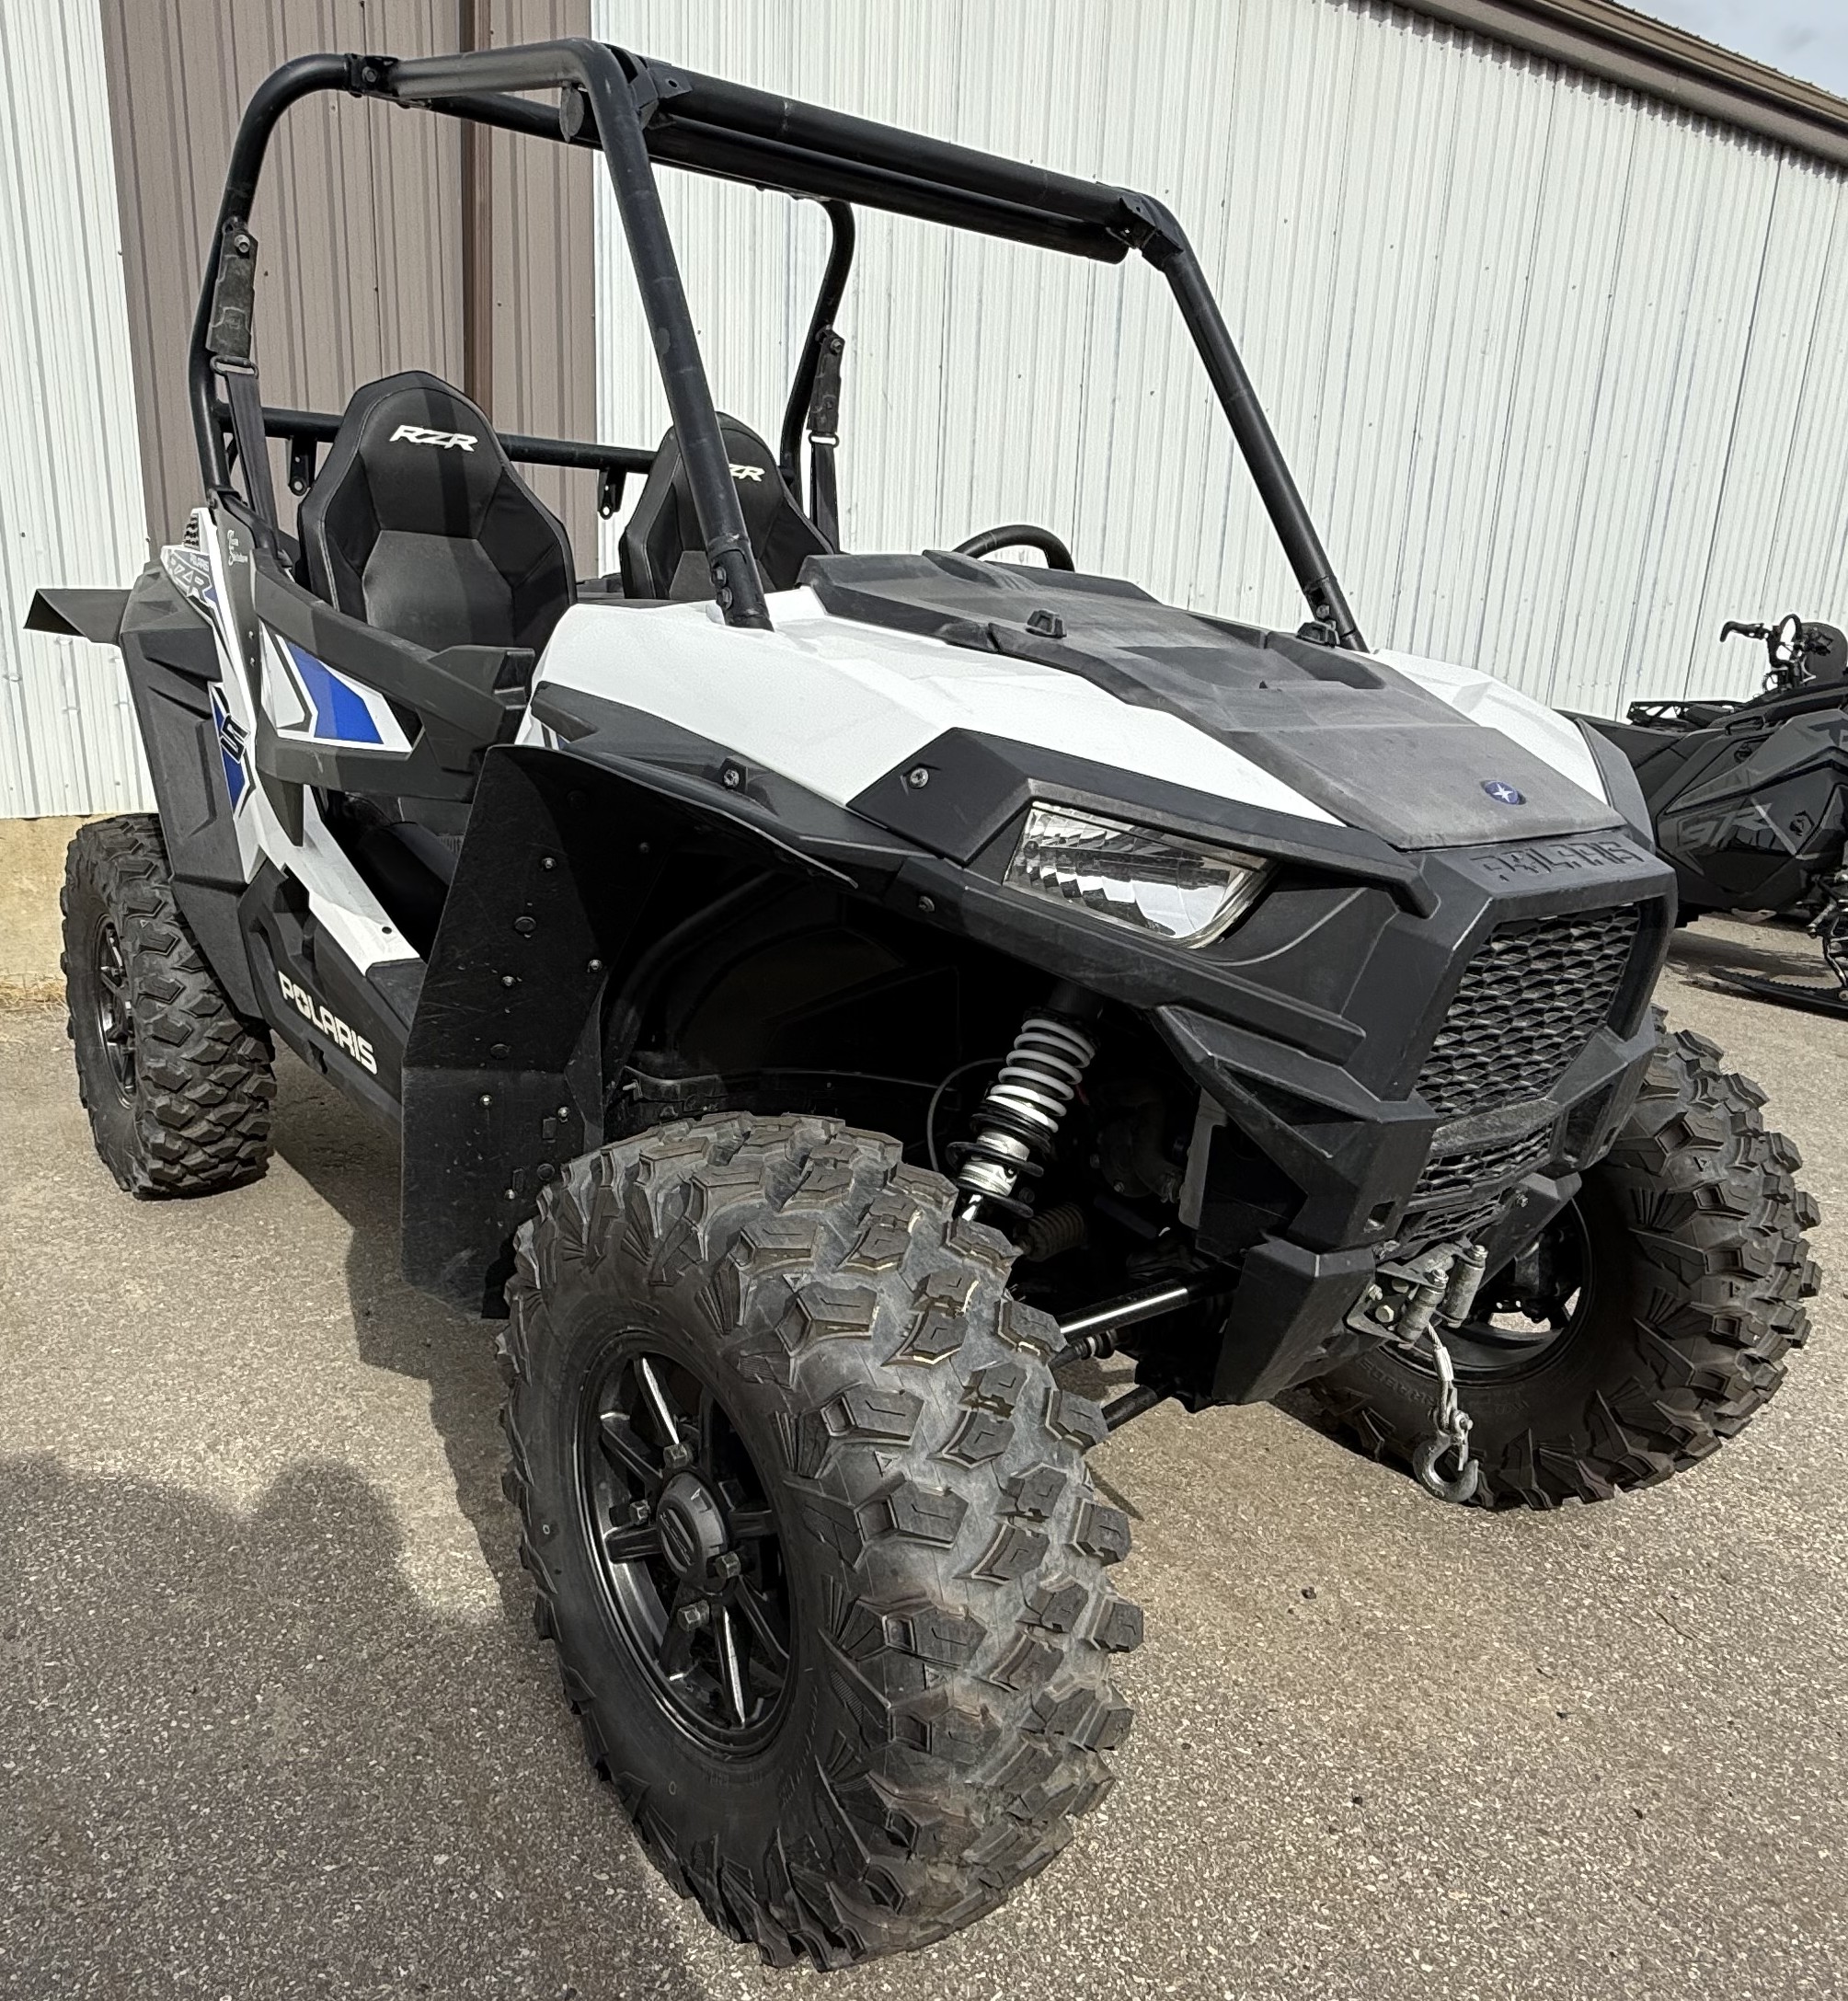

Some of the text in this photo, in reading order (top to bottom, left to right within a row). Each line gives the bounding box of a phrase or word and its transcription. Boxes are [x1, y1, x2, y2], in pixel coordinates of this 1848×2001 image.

[389, 425, 478, 452] RZR
[729, 463, 765, 482] ZR
[1470, 841, 1644, 882] POLARIS
[278, 971, 378, 1075] POLARIS
